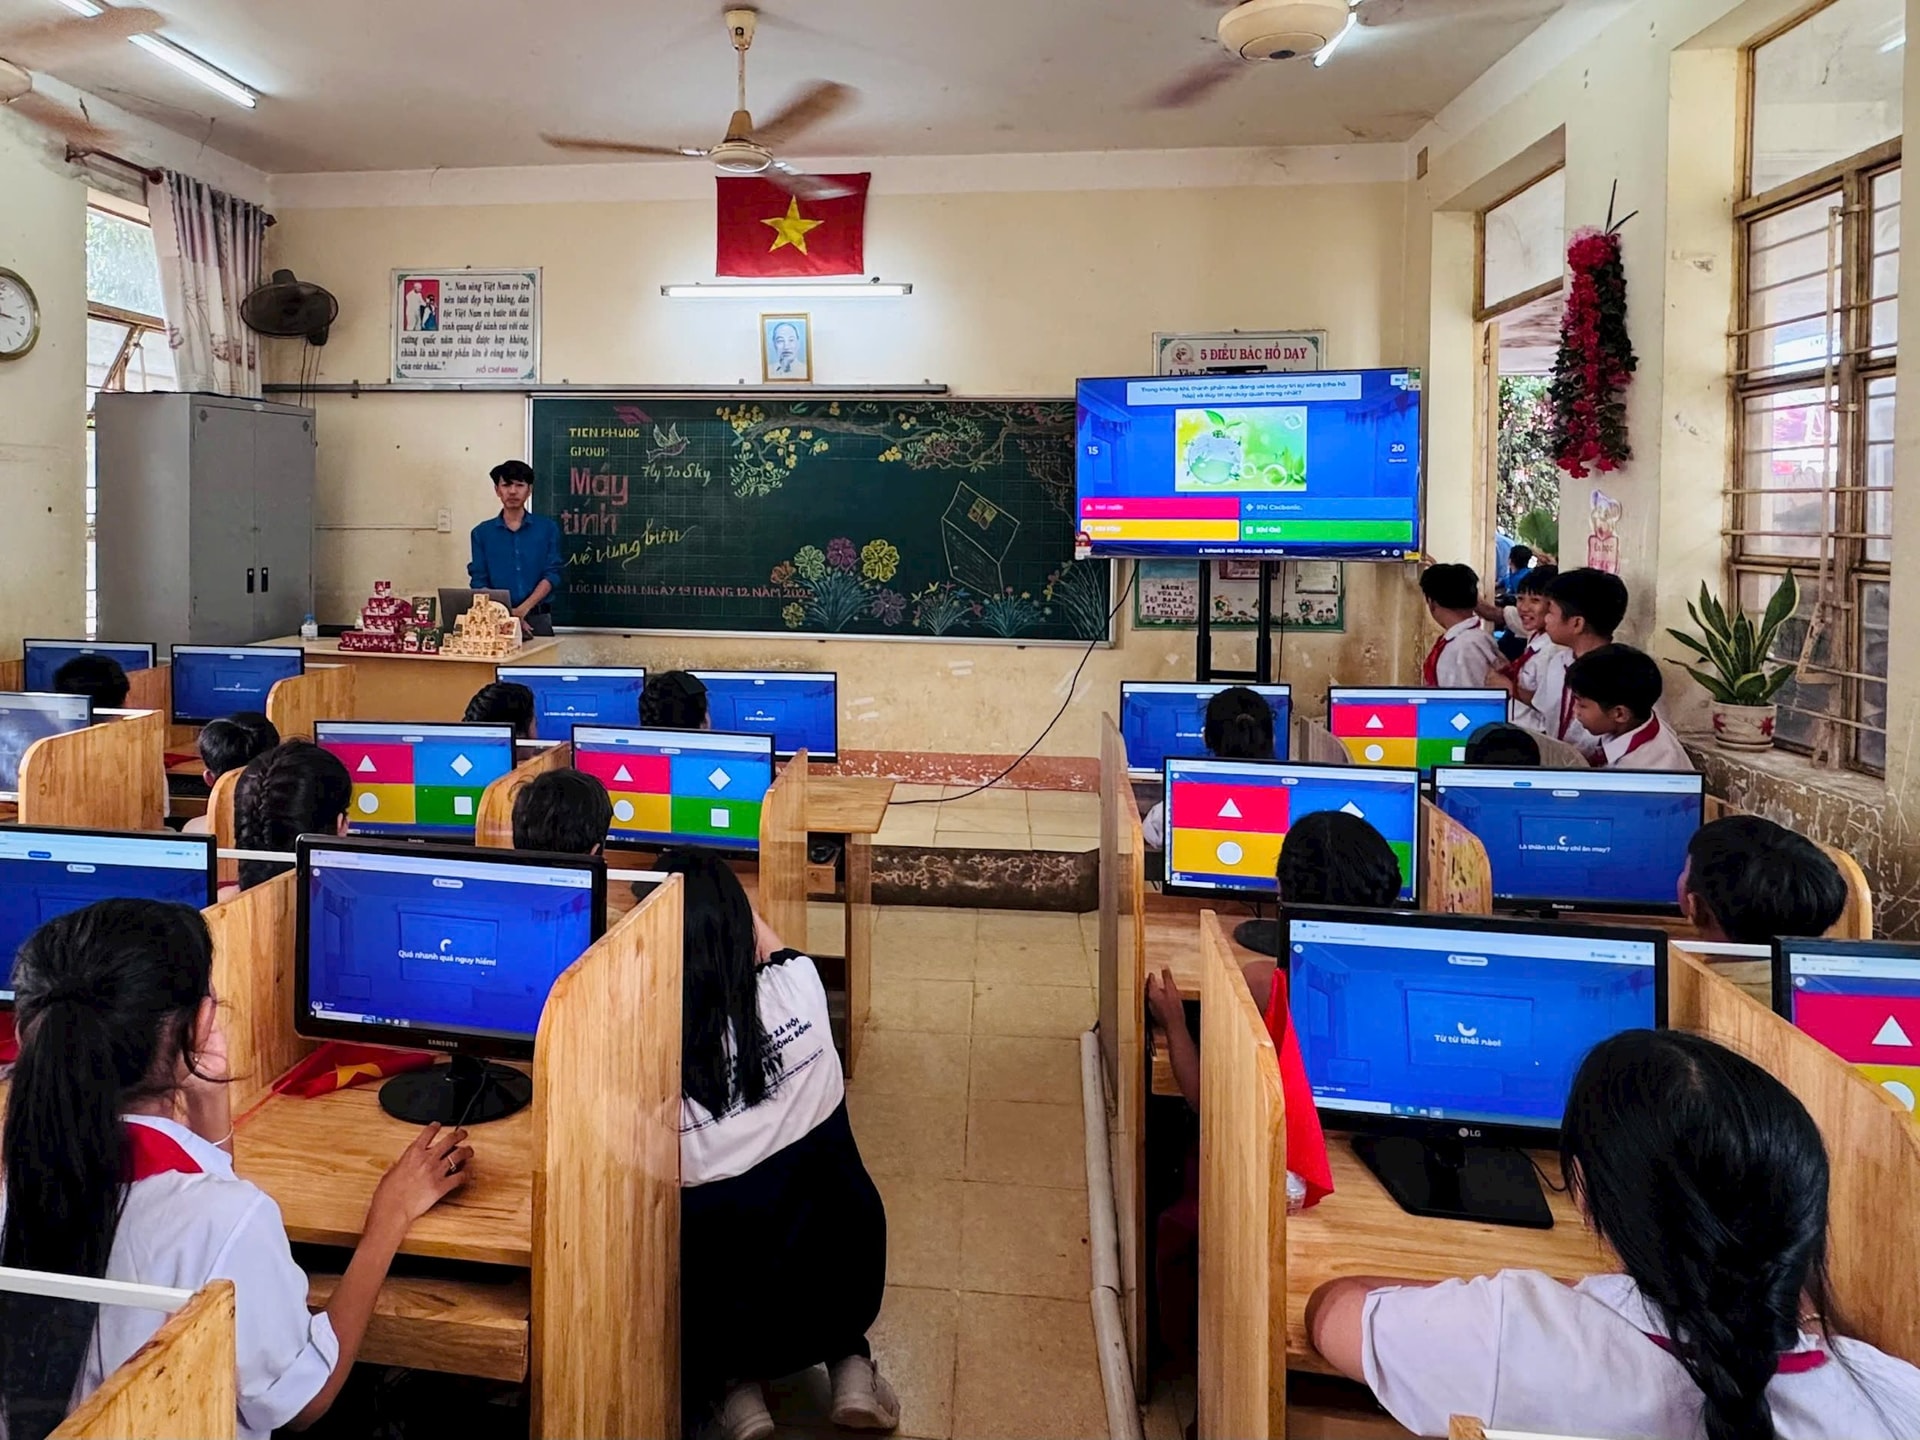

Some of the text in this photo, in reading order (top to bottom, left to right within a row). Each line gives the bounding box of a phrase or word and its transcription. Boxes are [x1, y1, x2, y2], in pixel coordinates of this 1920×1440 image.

[1200, 350, 1207, 360] 5
[1210, 343, 1237, 360] ĐIỀU
[1240, 345, 1262, 360] BÁC
[1284, 347, 1308, 362] DẠY
[1087, 446, 1099, 455] 15
[1391, 444, 1405, 453] 20
[682, 463, 711, 487] Sky
[570, 462, 629, 506] Máy
[737, 586, 750, 597] 12
[398, 949, 414, 959] Quá
[415, 951, 439, 960] nhanh
[439, 954, 454, 963] quá
[454, 956, 475, 965] nguy
[428, 1039, 458, 1048] SAMSUNG
[1434, 1034, 1447, 1043] Từ
[1448, 1035, 1459, 1044] từ
[1460, 1036, 1479, 1045] thôi
[1470, 1129, 1481, 1137] LG
